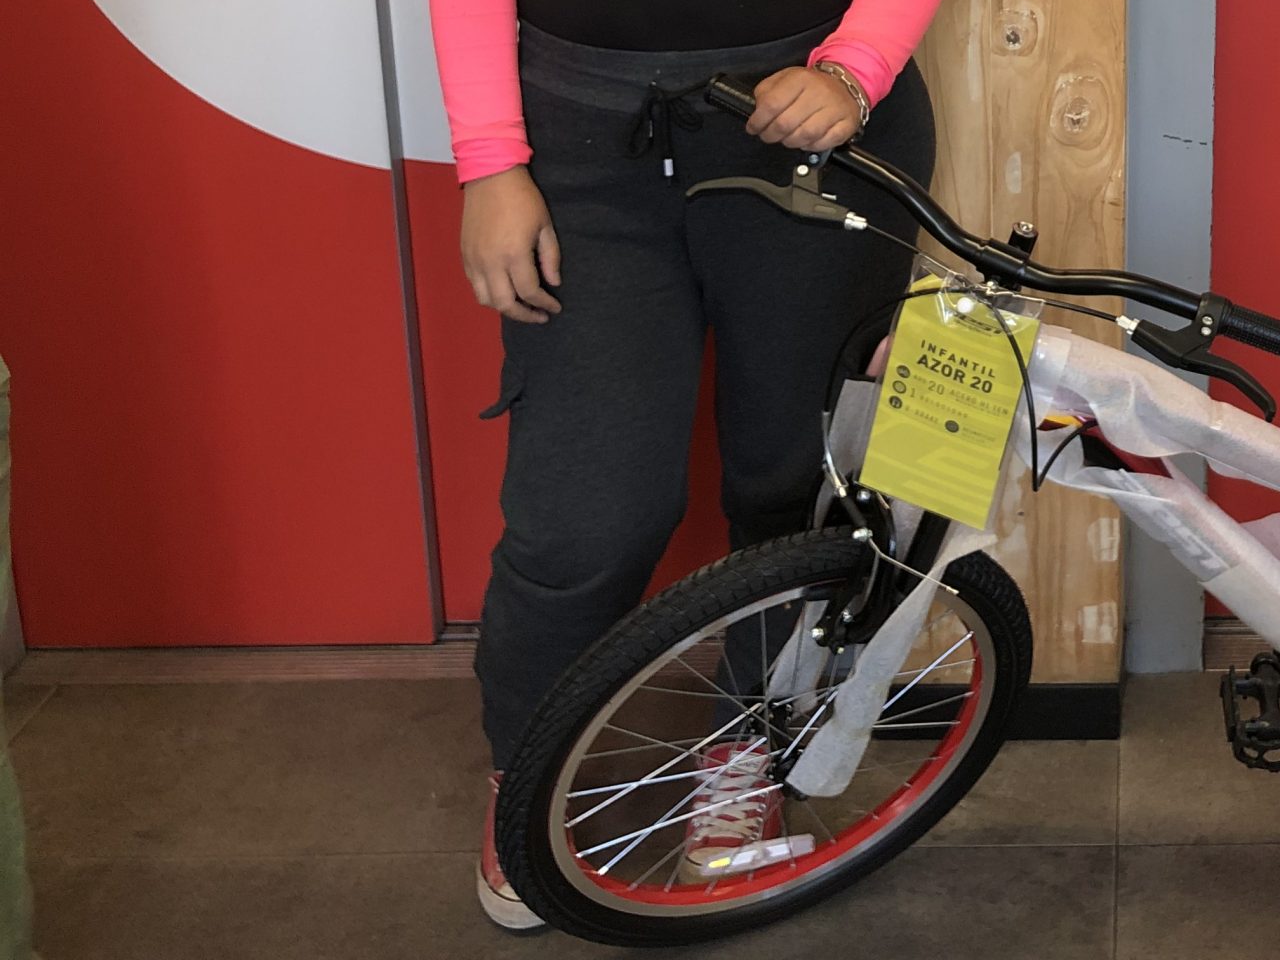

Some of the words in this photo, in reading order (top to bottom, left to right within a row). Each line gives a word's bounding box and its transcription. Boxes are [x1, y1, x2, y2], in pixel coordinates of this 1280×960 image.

[917, 354, 966, 383] AZOR
[969, 376, 993, 394] 20
[920, 339, 996, 378] INFANTIL
[928, 380, 945, 395] 20
